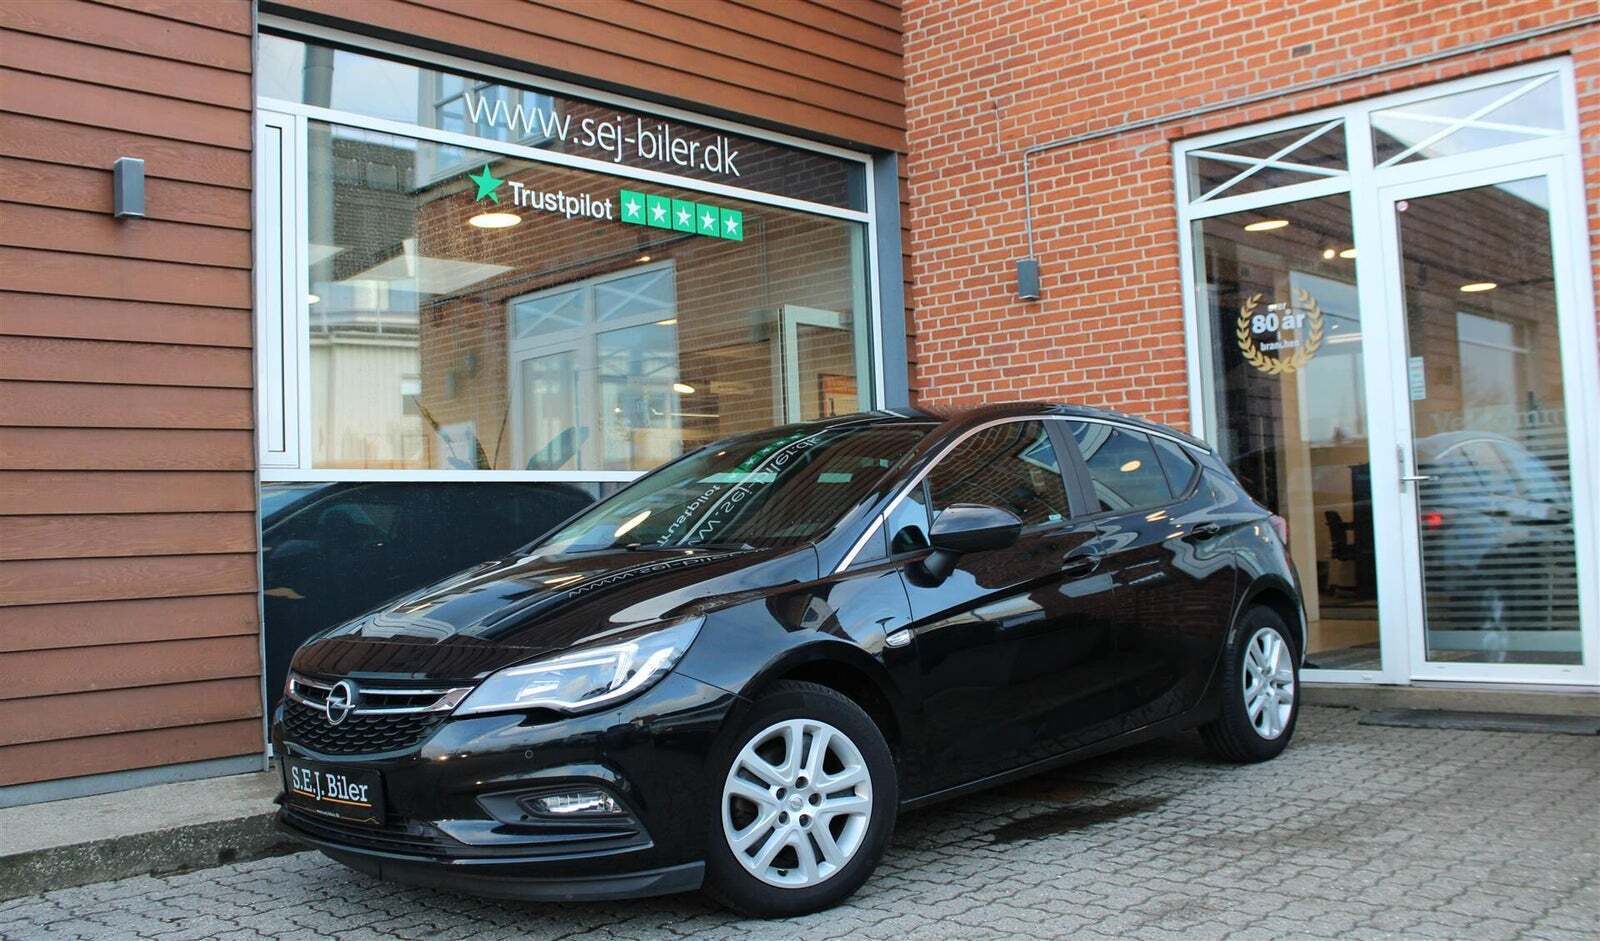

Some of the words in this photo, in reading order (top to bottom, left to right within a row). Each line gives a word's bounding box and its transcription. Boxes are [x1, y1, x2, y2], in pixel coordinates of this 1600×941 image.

[465, 93, 740, 177] www.sej-biler.dk
[508, 181, 613, 220] Trustpilot
[1252, 313, 1279, 334] 80
[1282, 308, 1305, 330] år
[291, 765, 325, 801] S.E.J.
[326, 773, 369, 802] Biler
